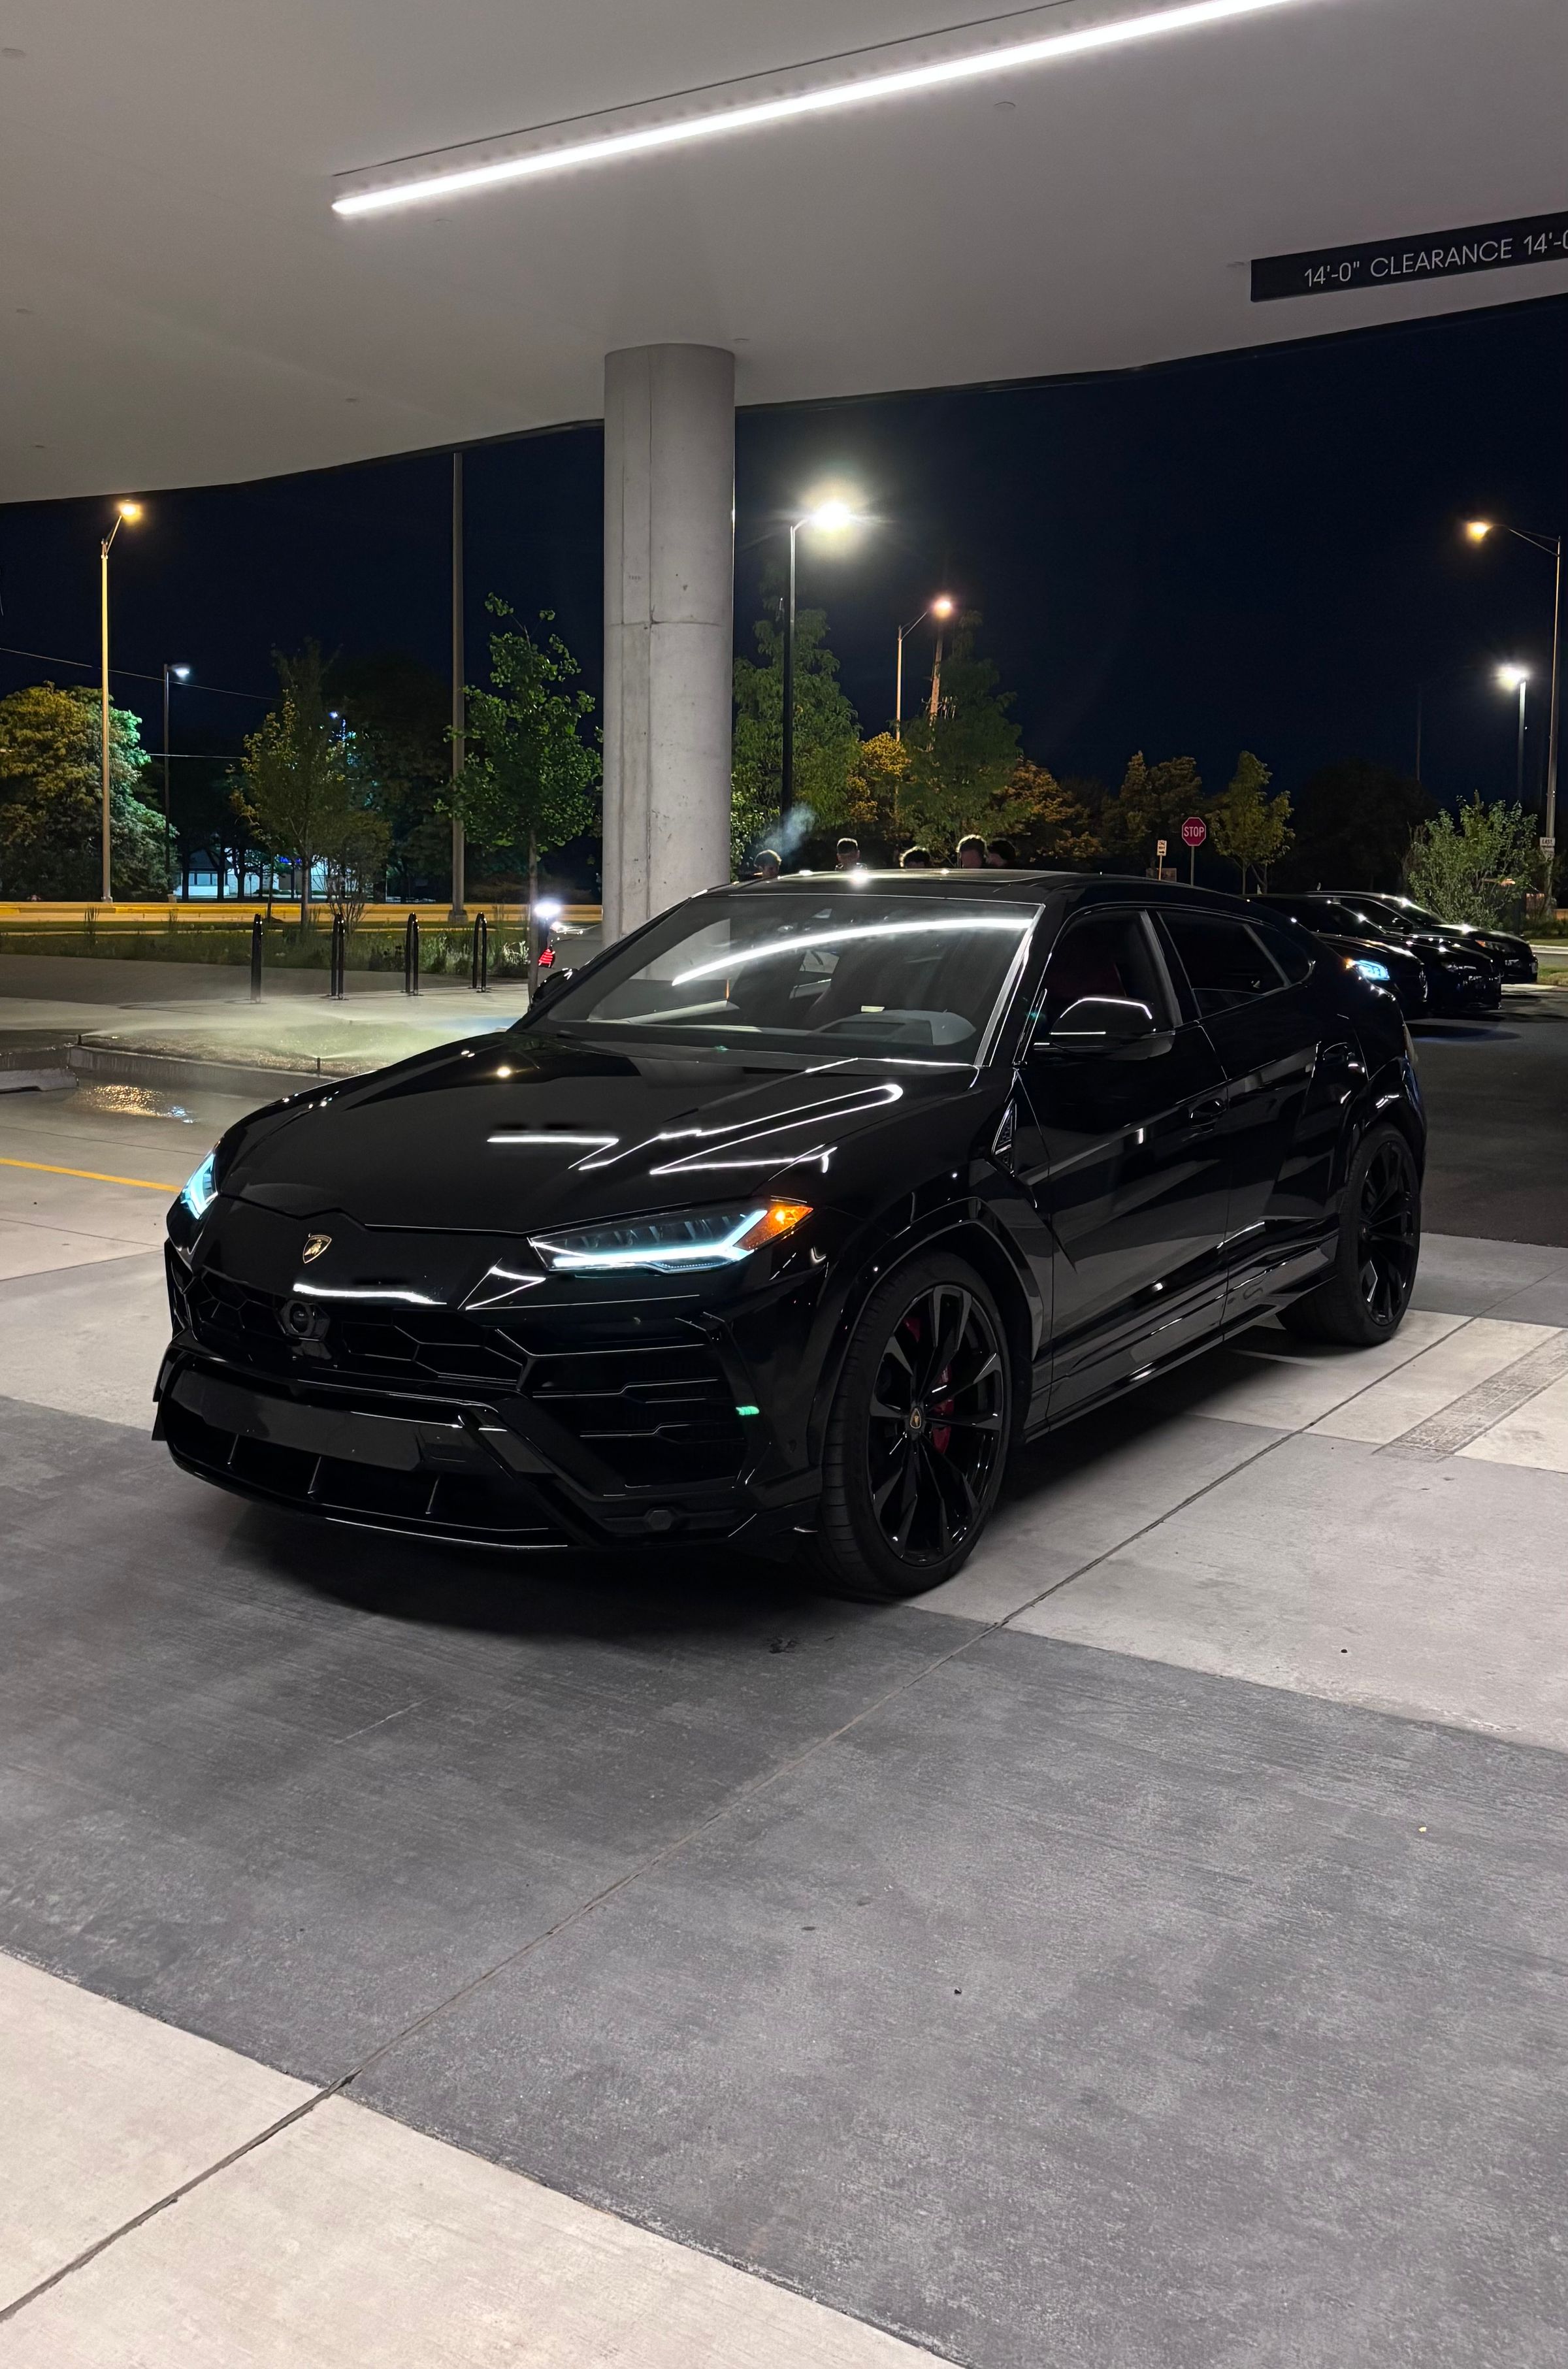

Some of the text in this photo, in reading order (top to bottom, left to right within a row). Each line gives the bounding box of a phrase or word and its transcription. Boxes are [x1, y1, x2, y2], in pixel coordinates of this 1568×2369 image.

[1305, 261, 1360, 287] 14'-0"
[1371, 238, 1513, 277] CLEARANCE
[1184, 826, 1205, 837] STOP
